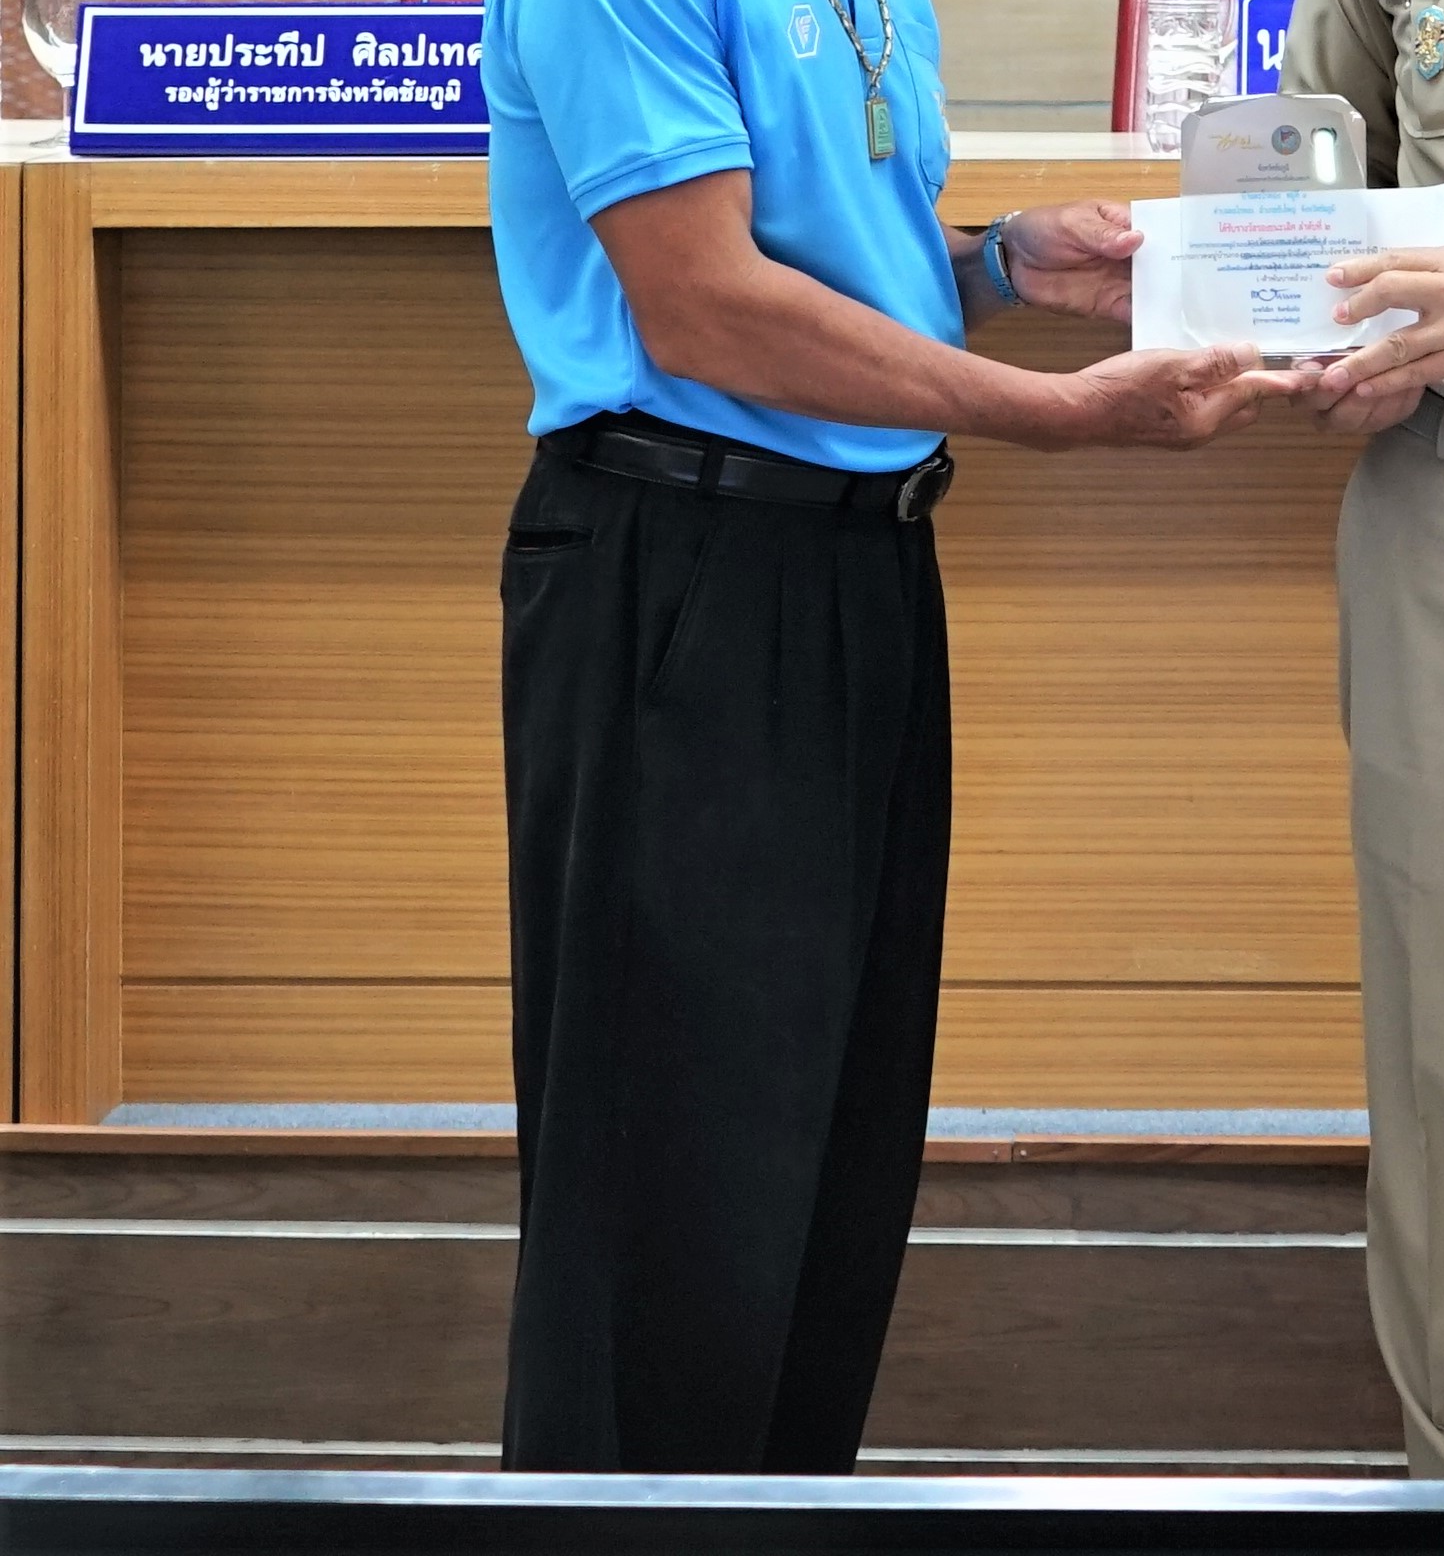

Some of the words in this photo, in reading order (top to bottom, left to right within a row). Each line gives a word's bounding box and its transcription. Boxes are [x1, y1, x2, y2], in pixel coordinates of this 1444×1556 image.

[139, 30, 325, 67] นายประทีป
[164, 77, 462, 111] รองผู้ว่าราชการจังหวัดชัยภูมิ
